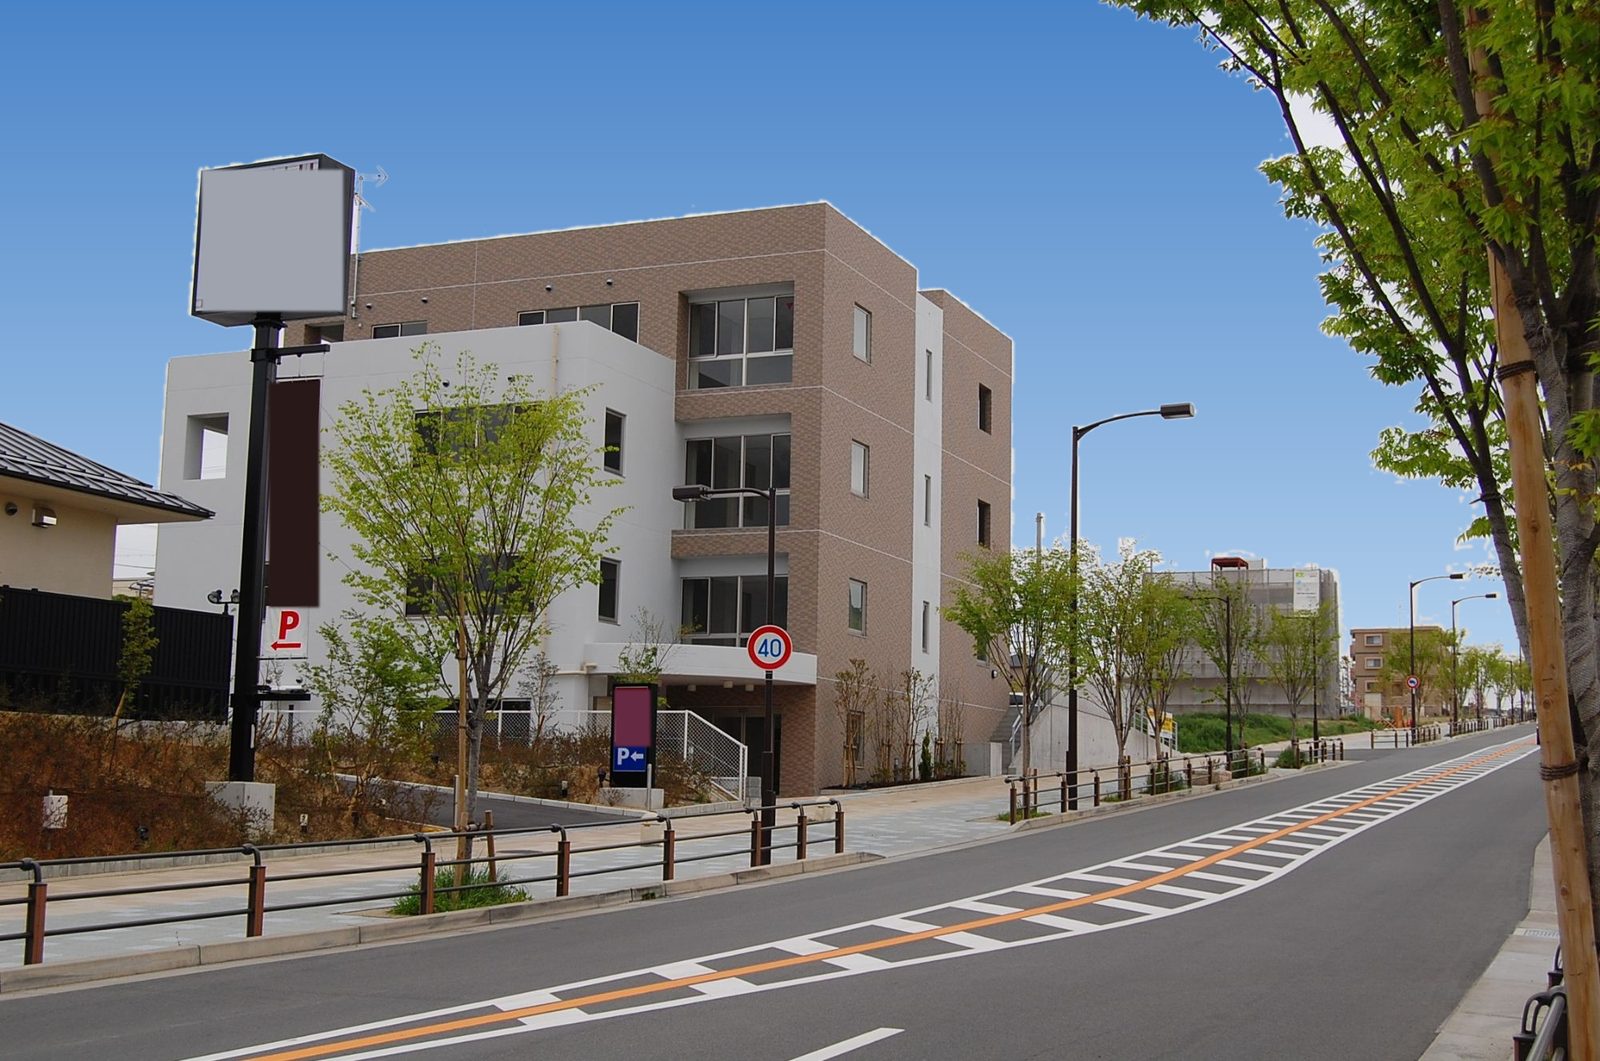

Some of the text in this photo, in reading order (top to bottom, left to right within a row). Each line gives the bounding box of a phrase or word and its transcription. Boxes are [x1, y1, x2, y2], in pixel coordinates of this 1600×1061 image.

[279, 611, 300, 640] P
[758, 638, 781, 657] 40
[617, 747, 630, 765] P
